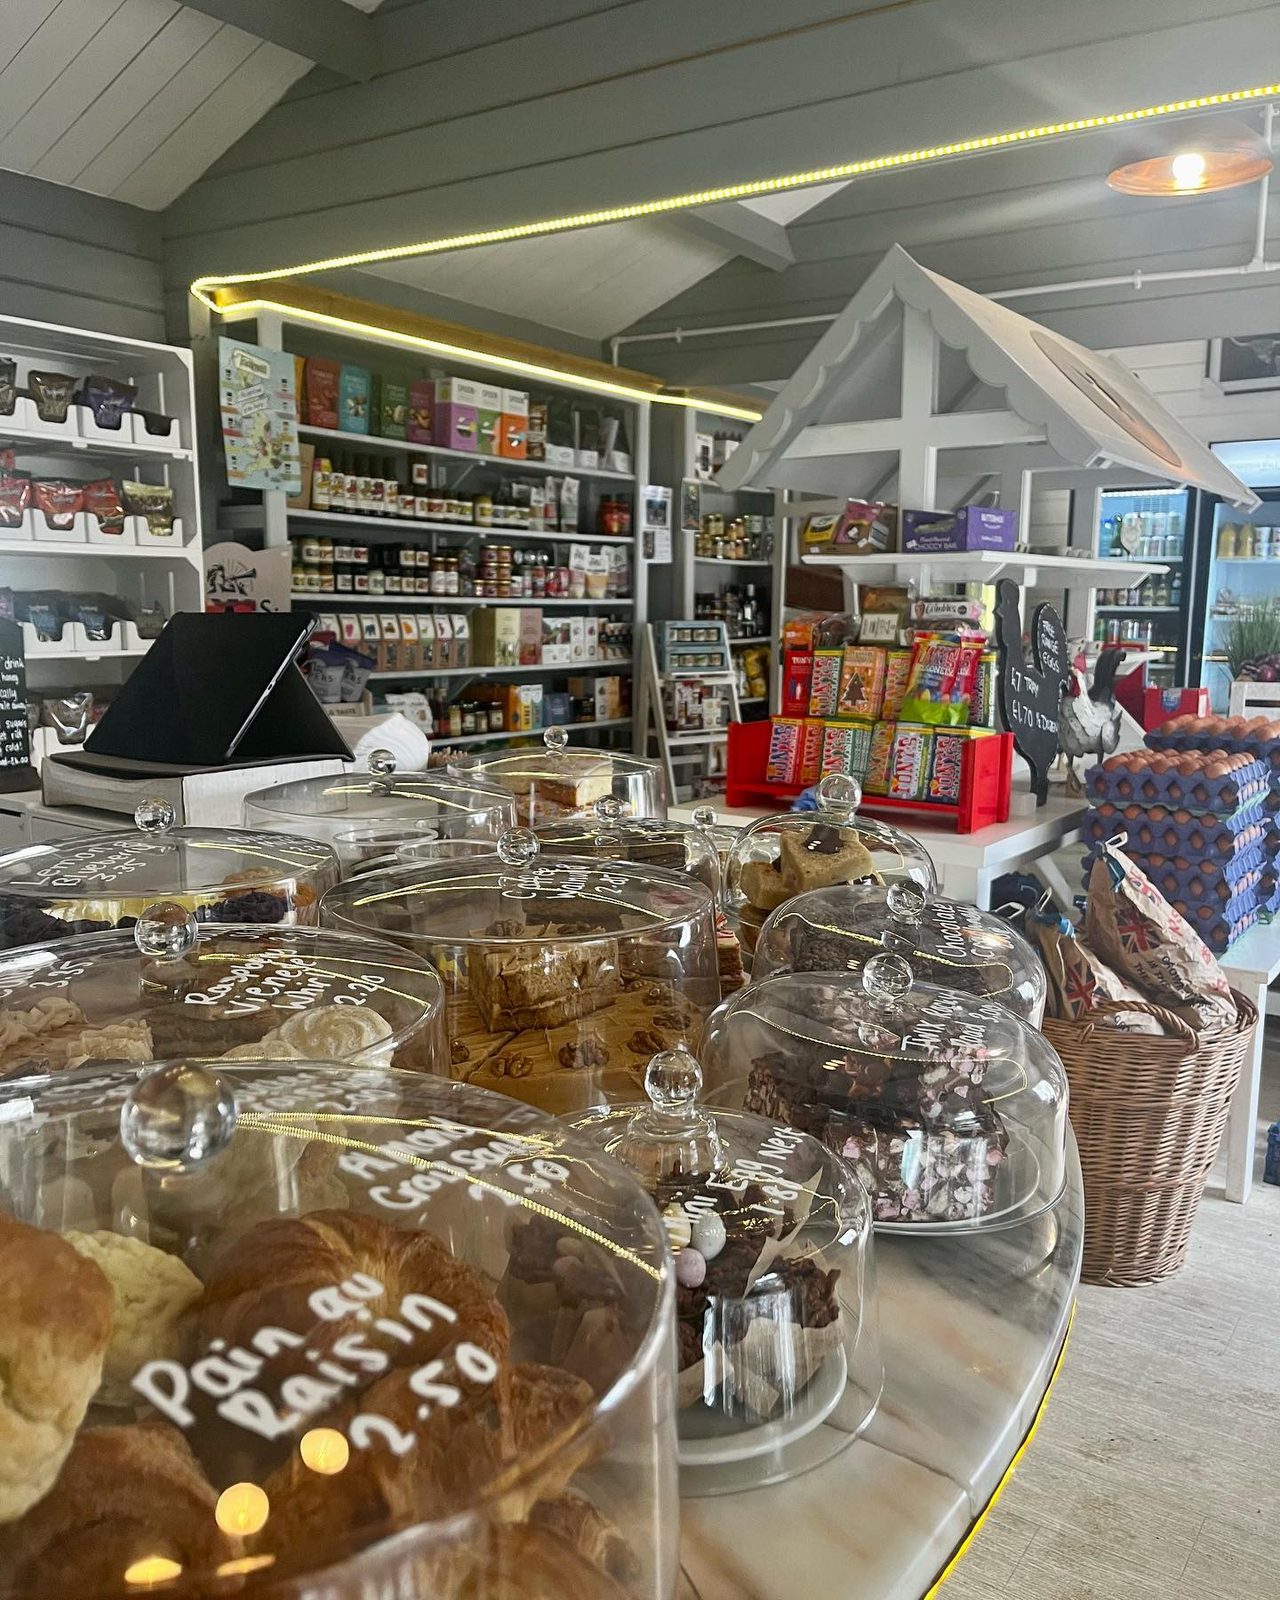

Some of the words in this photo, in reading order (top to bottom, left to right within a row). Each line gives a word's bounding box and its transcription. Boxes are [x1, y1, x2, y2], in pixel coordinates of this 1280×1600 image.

[1042, 651, 1060, 674] EGGS
[10, 846, 113, 886] Lemon
[88, 858, 147, 882] 3.35
[932, 903, 967, 958] Chocolate
[29, 961, 94, 988] 3.35
[271, 970, 338, 1011] Whirl
[333, 974, 386, 1006] 2.20
[707, 1158, 786, 1192] Egg
[757, 1126, 806, 1161] Nest
[132, 1323, 306, 1427] Pain
[308, 1272, 384, 1321] au
[219, 1291, 457, 1440] Raisin
[350, 1342, 500, 1456] 2.50
